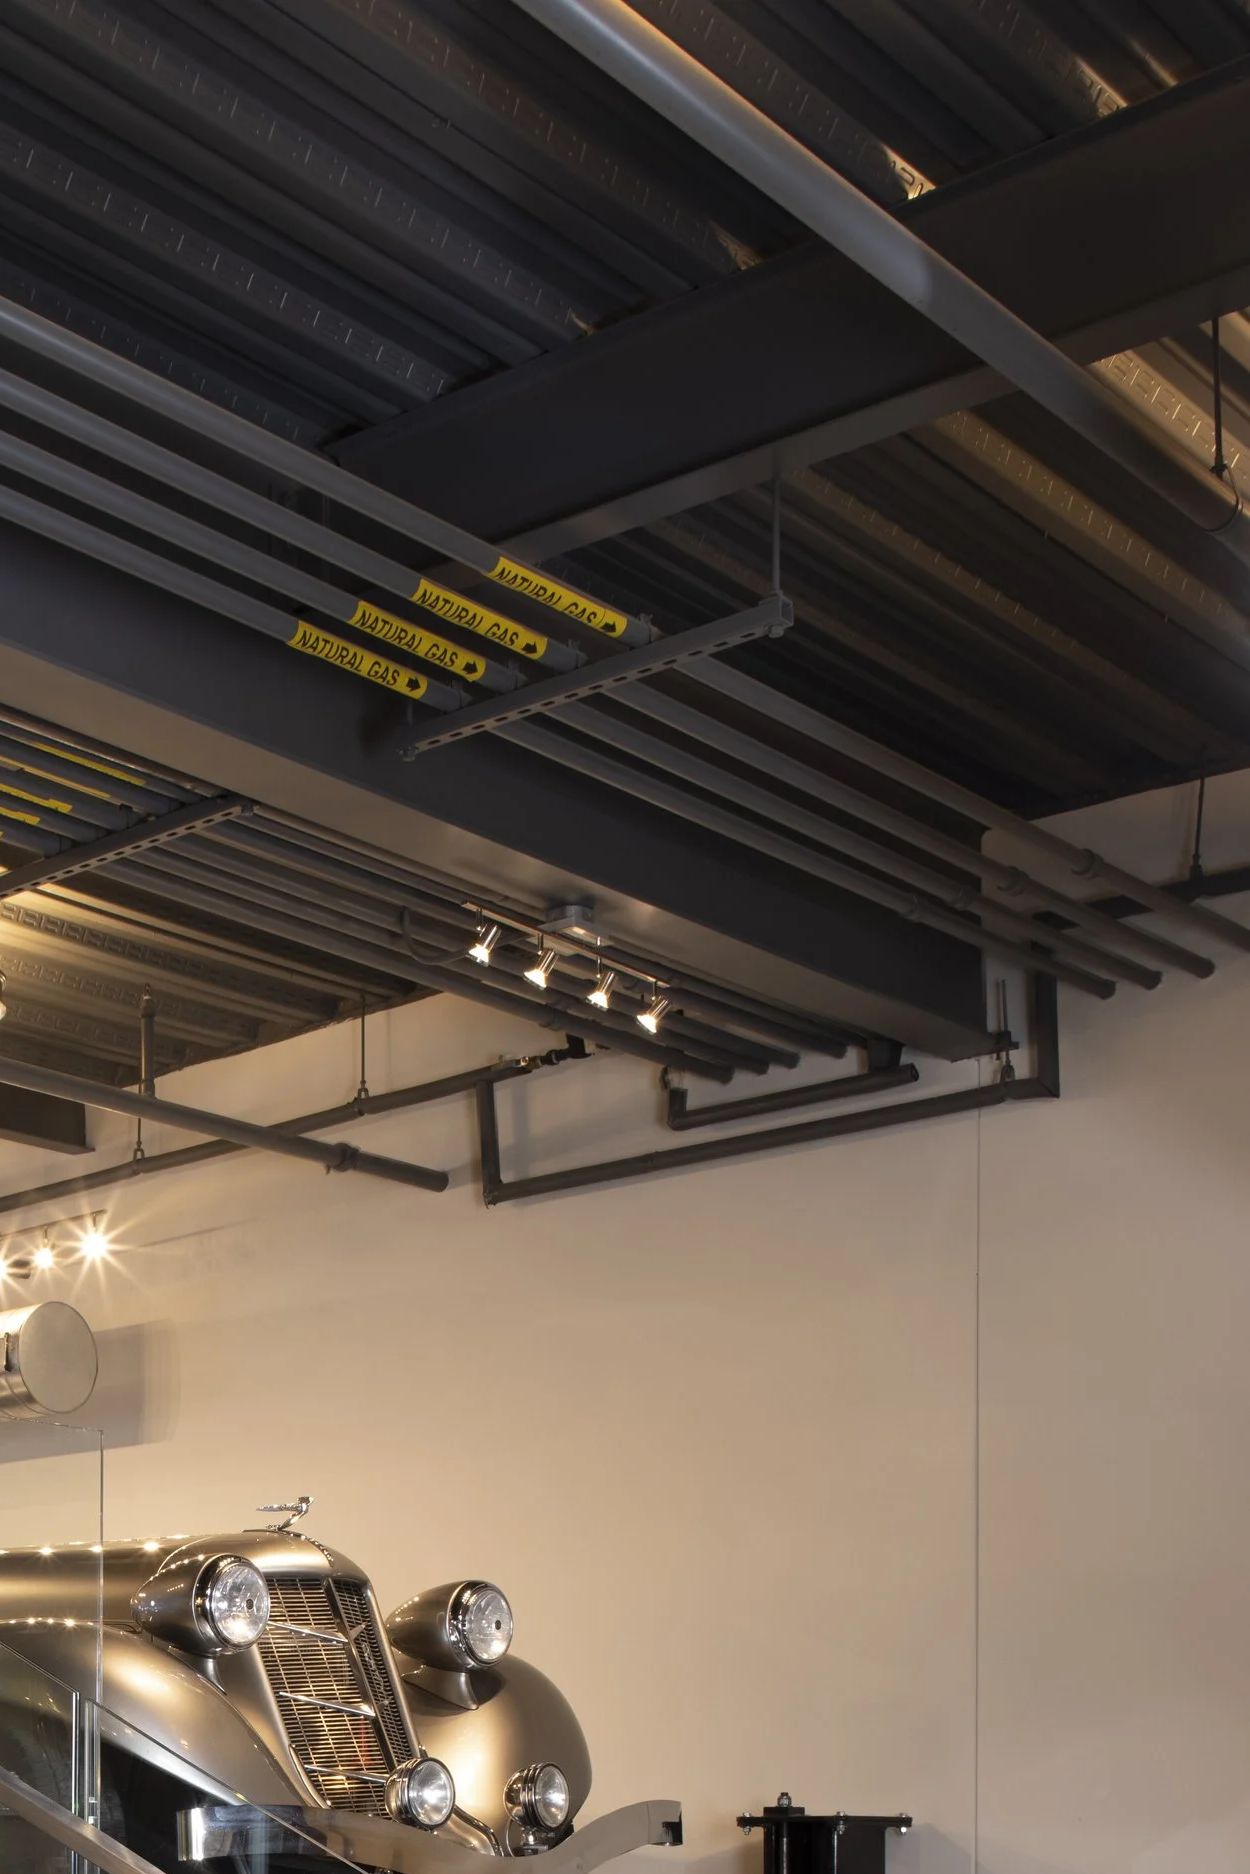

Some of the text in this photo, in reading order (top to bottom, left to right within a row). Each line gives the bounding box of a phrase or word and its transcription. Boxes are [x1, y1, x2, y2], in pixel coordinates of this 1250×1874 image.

[355, 609, 459, 668] NATURAL GAS
[417, 588, 519, 647] NATURAL GAS
[296, 629, 400, 687] NATURAL GAS
